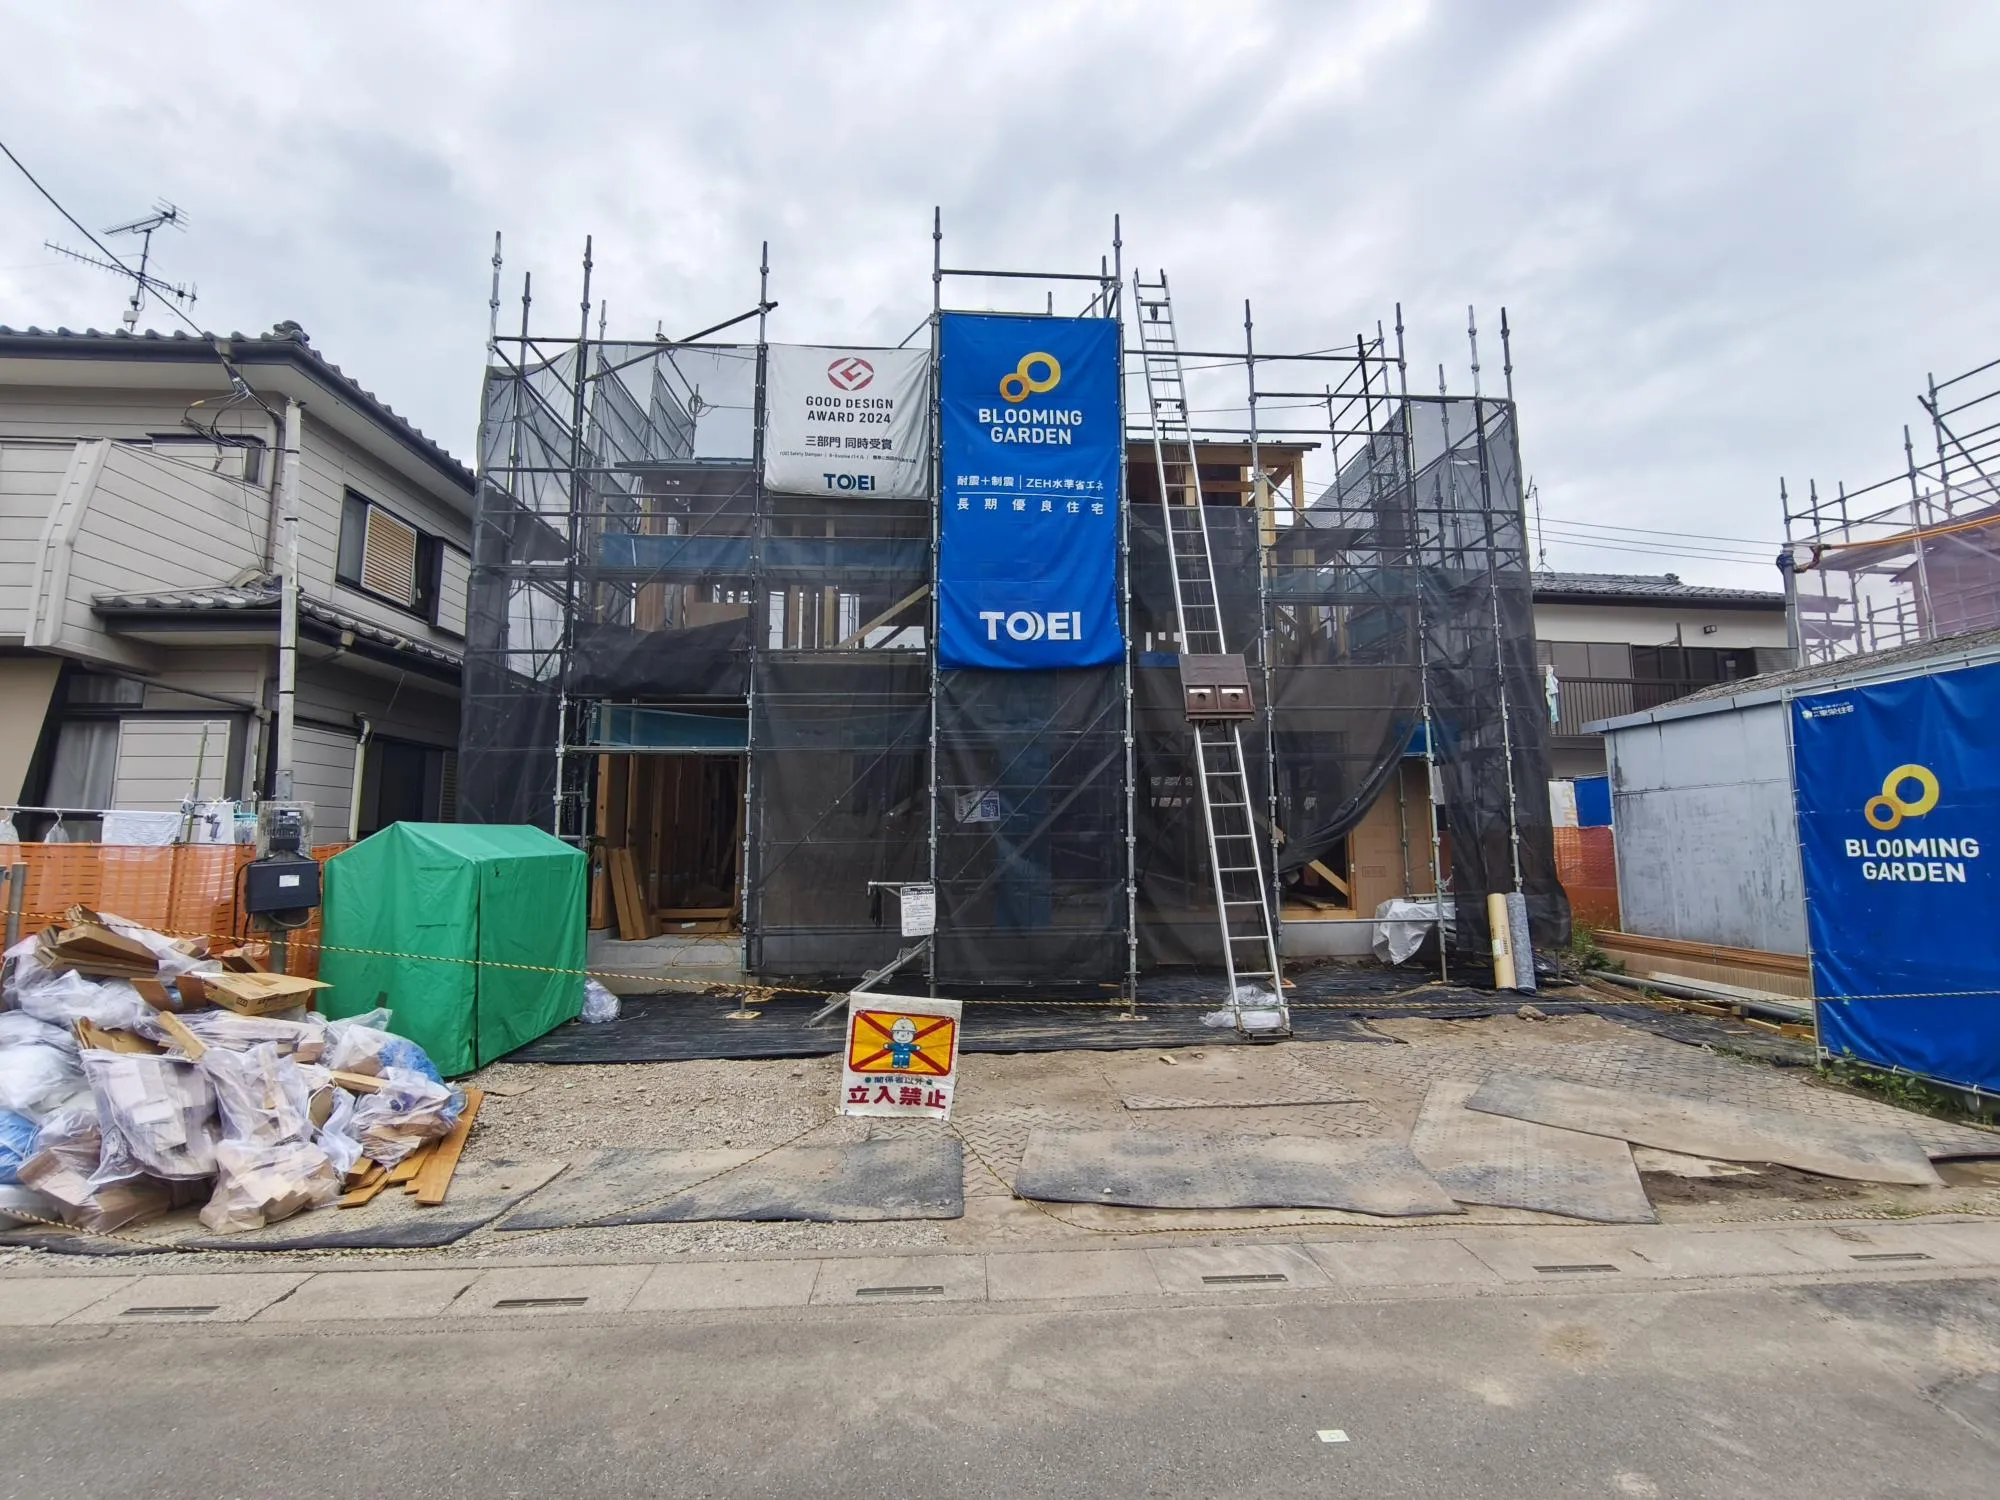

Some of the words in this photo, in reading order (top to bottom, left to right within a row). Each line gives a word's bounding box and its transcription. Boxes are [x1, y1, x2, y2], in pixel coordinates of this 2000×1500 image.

[806, 396, 841, 408] GOOD
[845, 398, 893, 410] DESIGN
[807, 410, 854, 423] AWARD
[859, 413, 891, 424] 2024
[978, 408, 1083, 426] BLOOMING
[805, 435, 841, 448] 三部門
[845, 437, 893, 450] 同時受賞
[990, 427, 1072, 445] GARDEN
[823, 473, 876, 491] TOEI
[1025, 478, 1104, 491] ZEH水準省エネ
[956, 497, 1104, 515] 長期優良住宅
[979, 611, 1082, 641] TOEI
[1845, 838, 1980, 858] BLOOMING
[1862, 862, 1967, 883] GARDEN
[847, 1085, 946, 1109] 立入禁止
